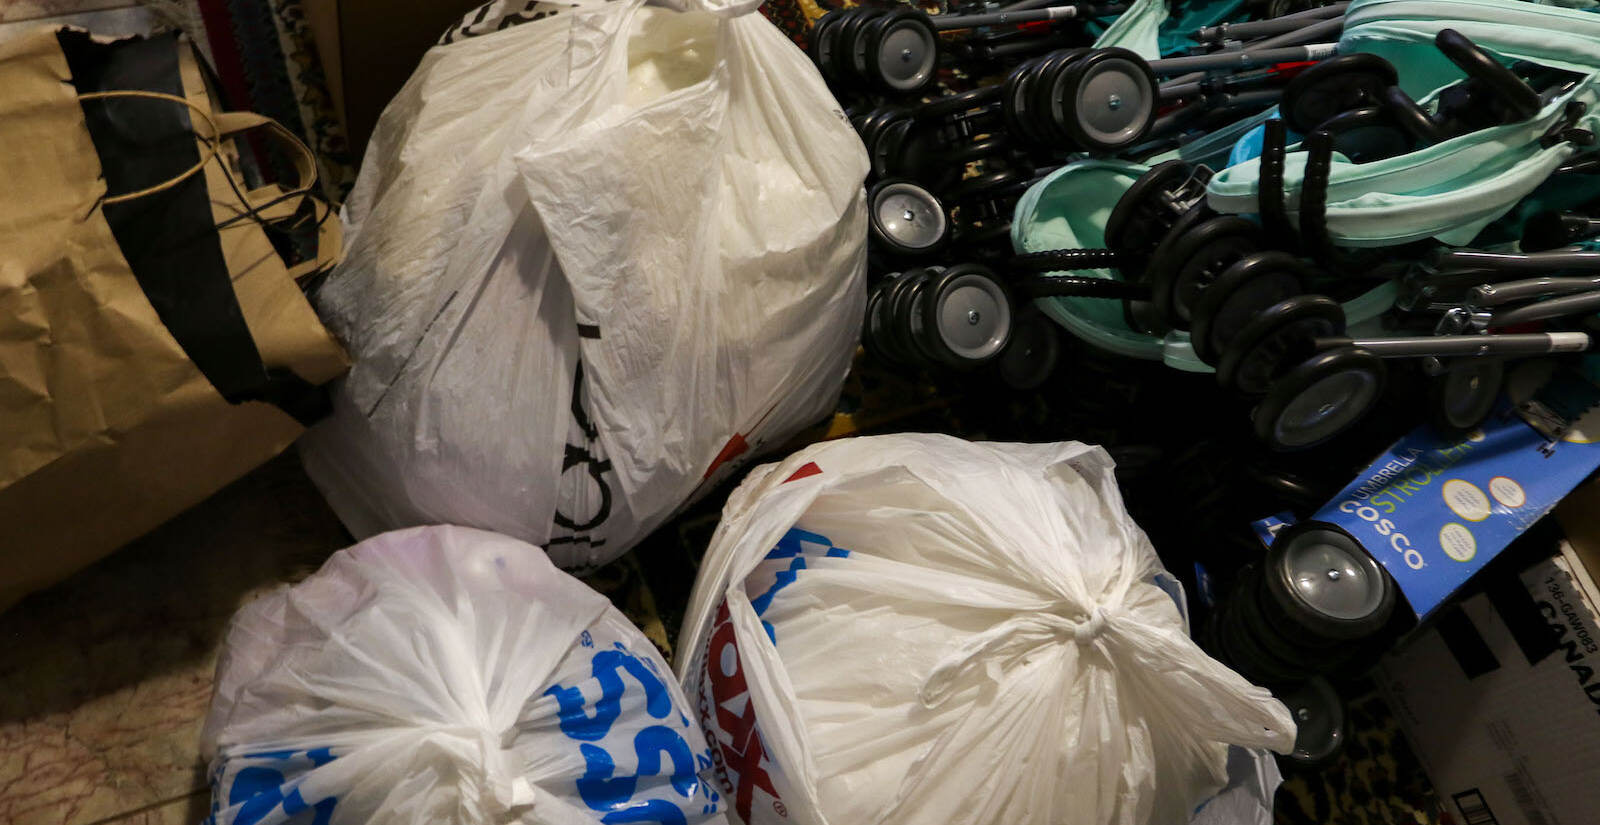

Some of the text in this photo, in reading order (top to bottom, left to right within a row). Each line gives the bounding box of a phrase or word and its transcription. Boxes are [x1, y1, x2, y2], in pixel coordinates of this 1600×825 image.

[1351, 448, 1423, 500] UMBRELLA
[1369, 442, 1473, 513] STROER
[1339, 500, 1424, 570] COSCO
[1537, 600, 1600, 714] CANAD
